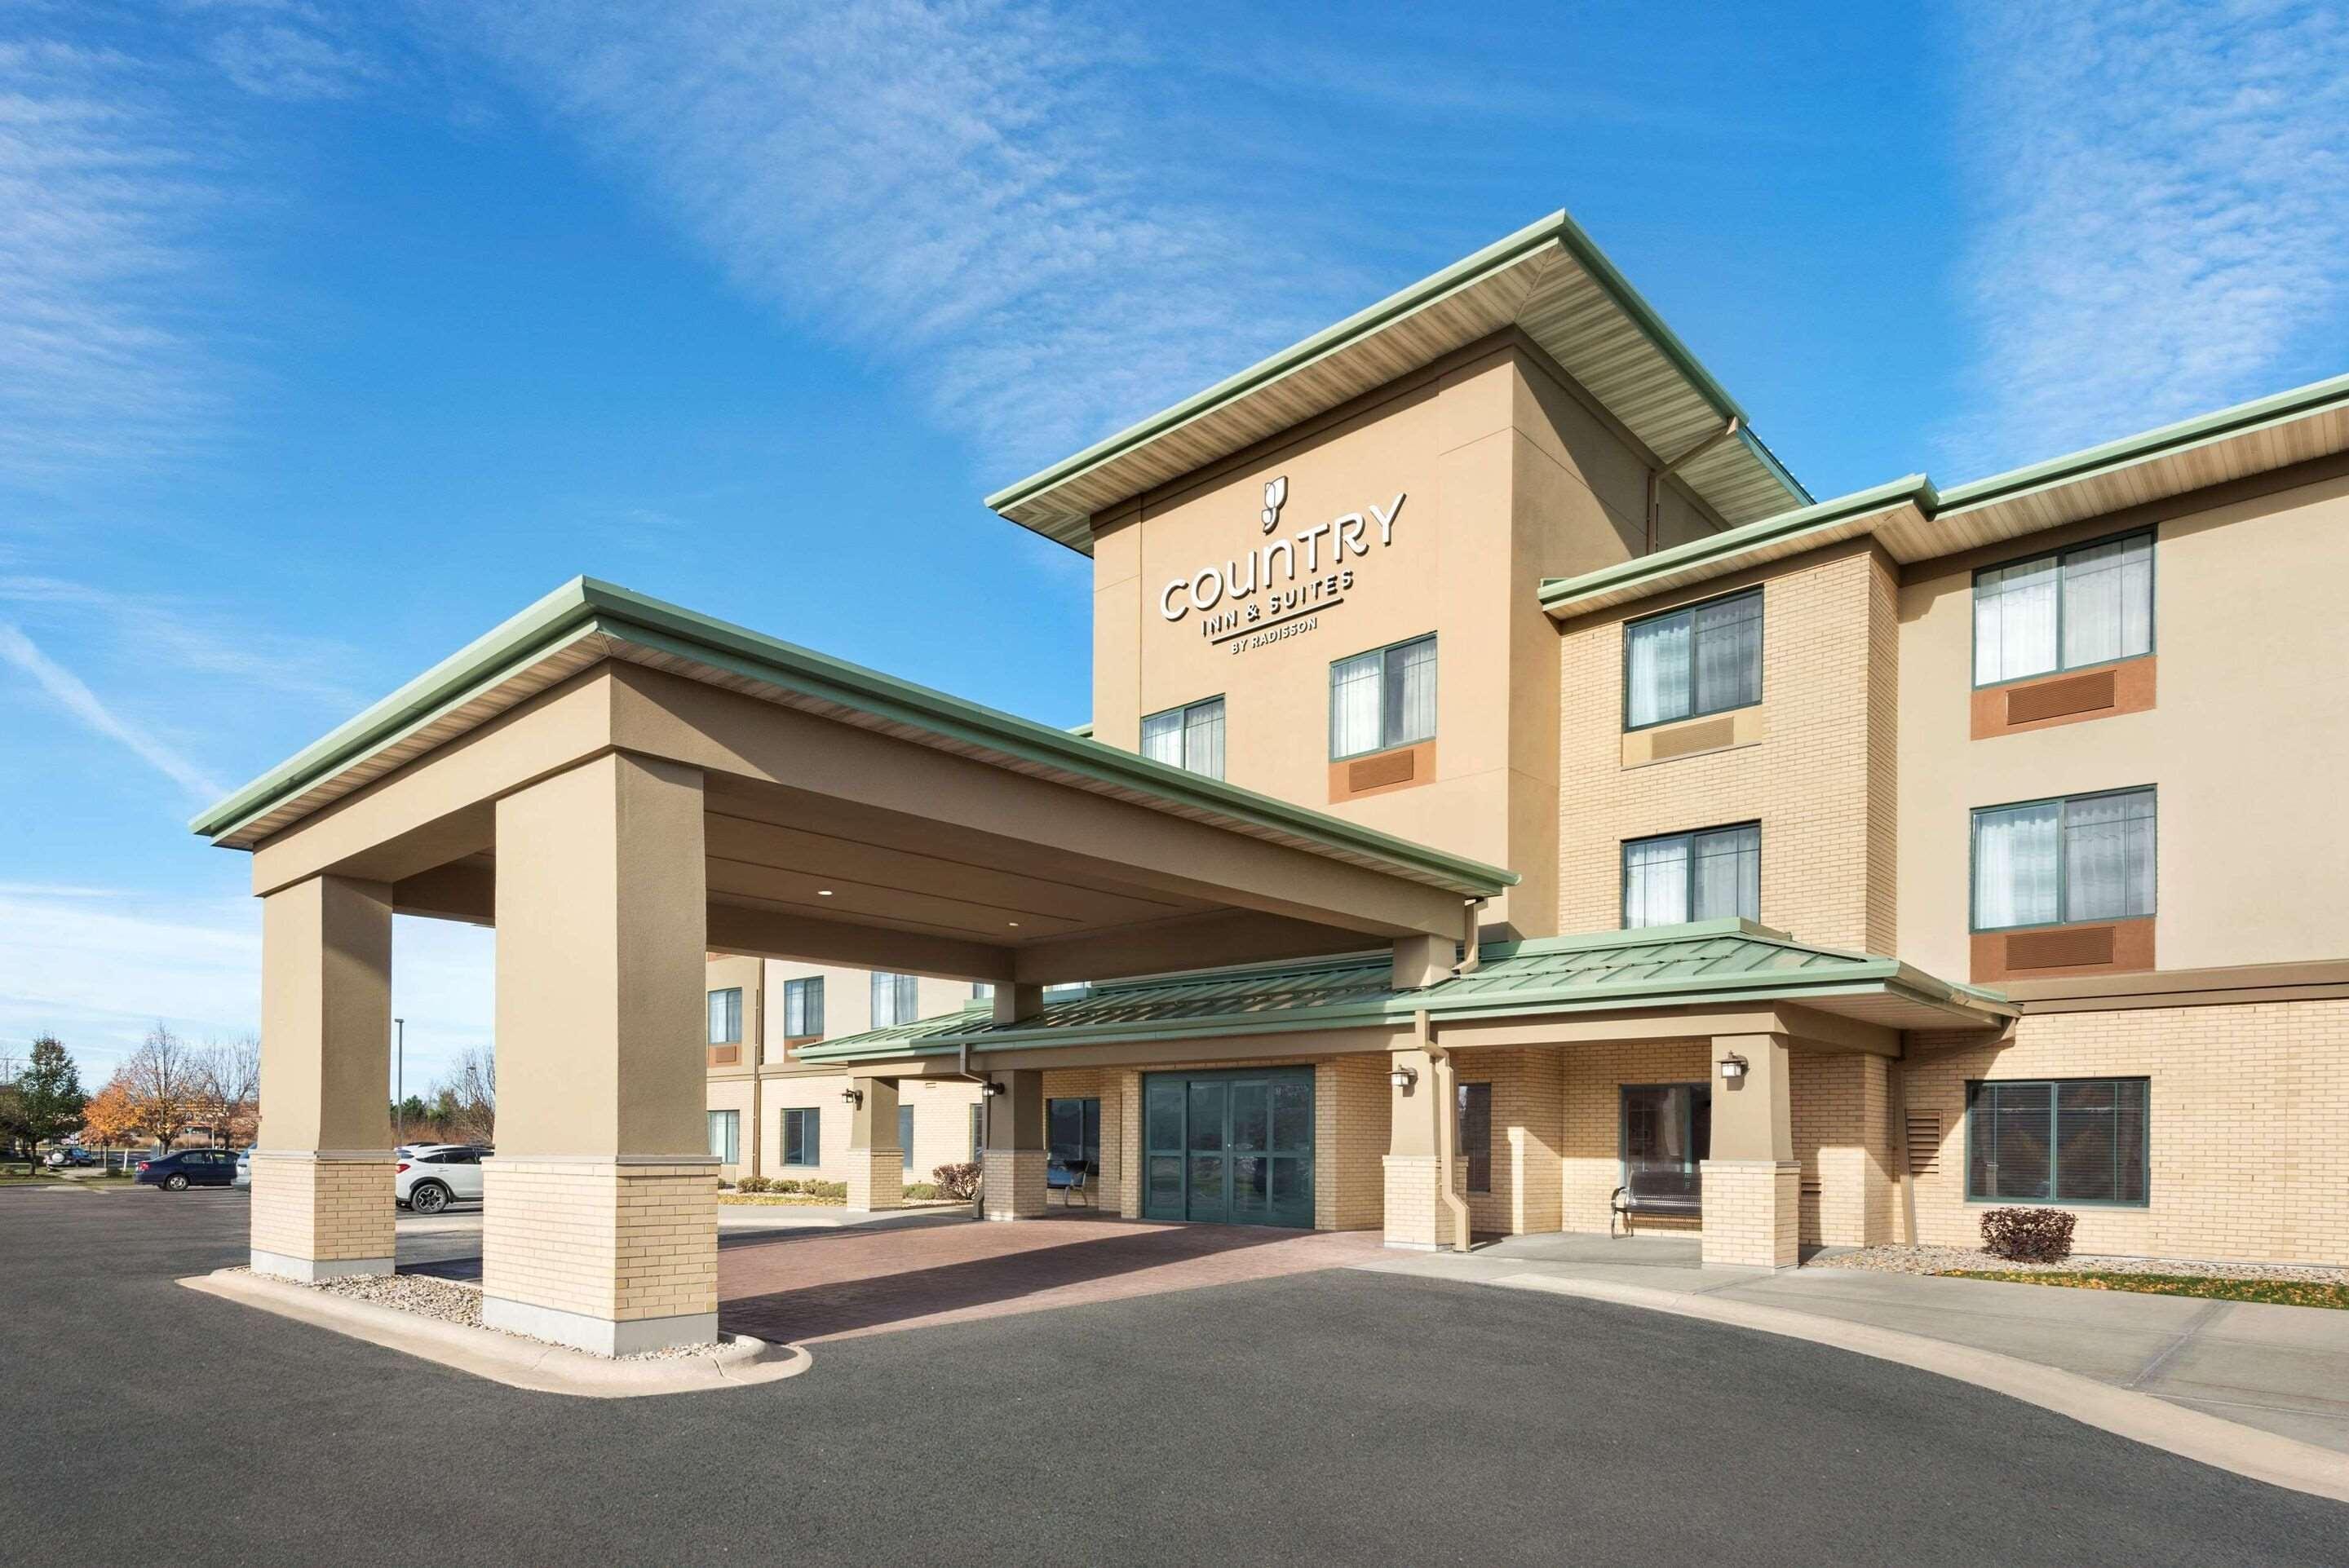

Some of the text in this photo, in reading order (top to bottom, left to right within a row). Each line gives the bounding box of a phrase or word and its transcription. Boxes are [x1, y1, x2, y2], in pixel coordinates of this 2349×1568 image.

[1201, 569, 1353, 637] INN & SUITES
[1231, 617, 1317, 654] BY RADISSON
